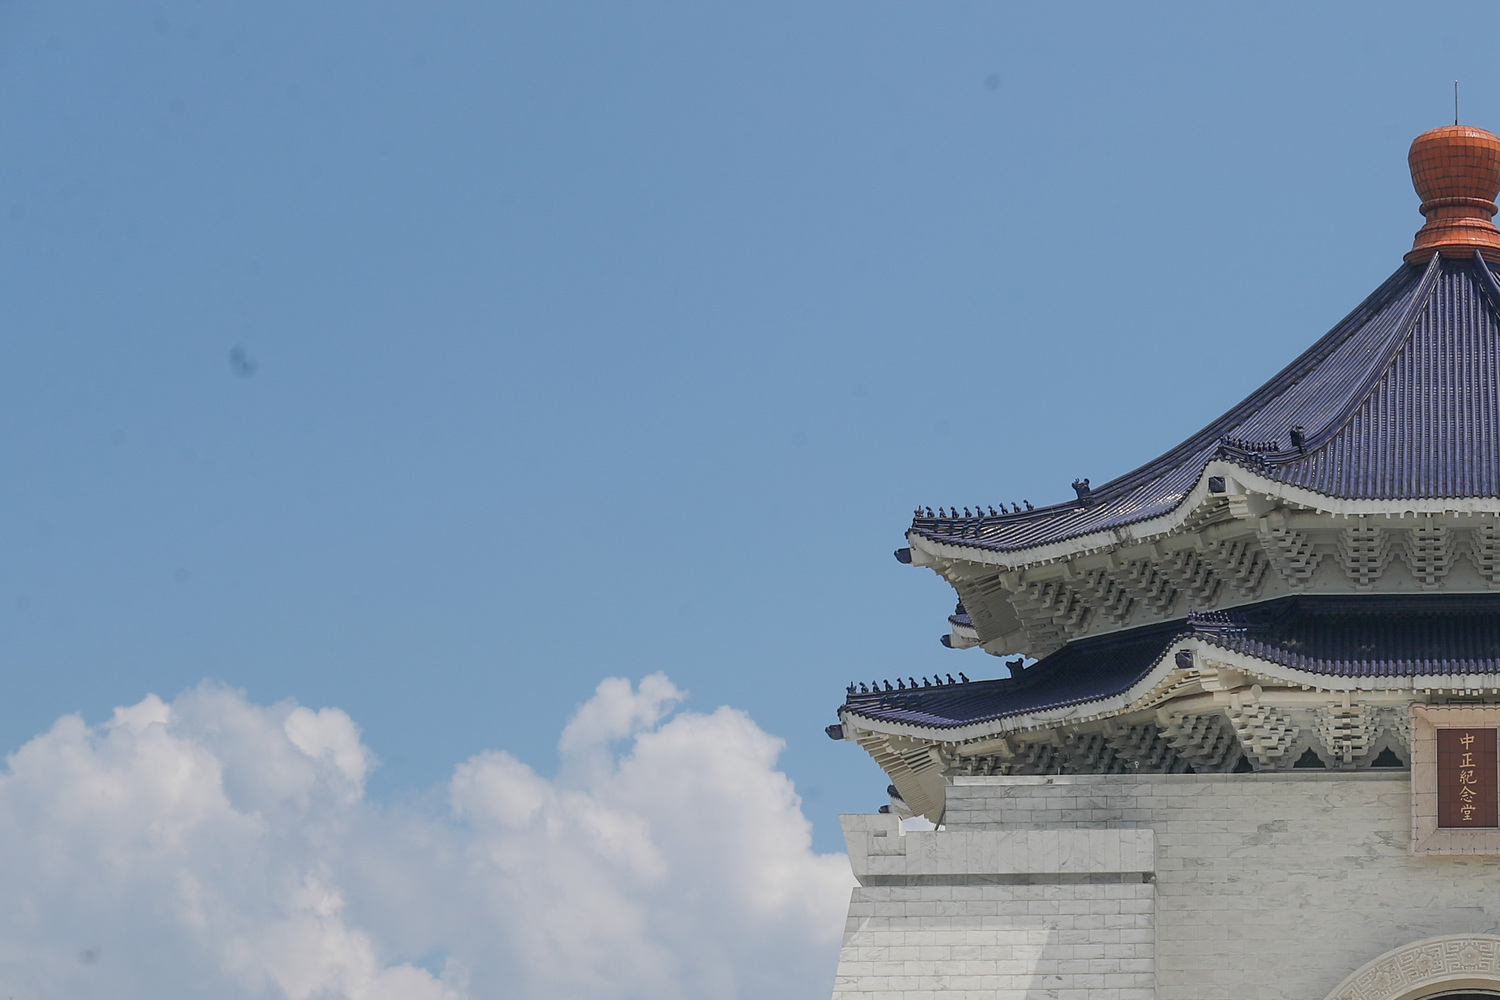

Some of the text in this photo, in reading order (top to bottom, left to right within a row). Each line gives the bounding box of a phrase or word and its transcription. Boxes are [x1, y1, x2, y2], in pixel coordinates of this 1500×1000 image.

[1459, 733, 1478, 821] 中正紀念堂
